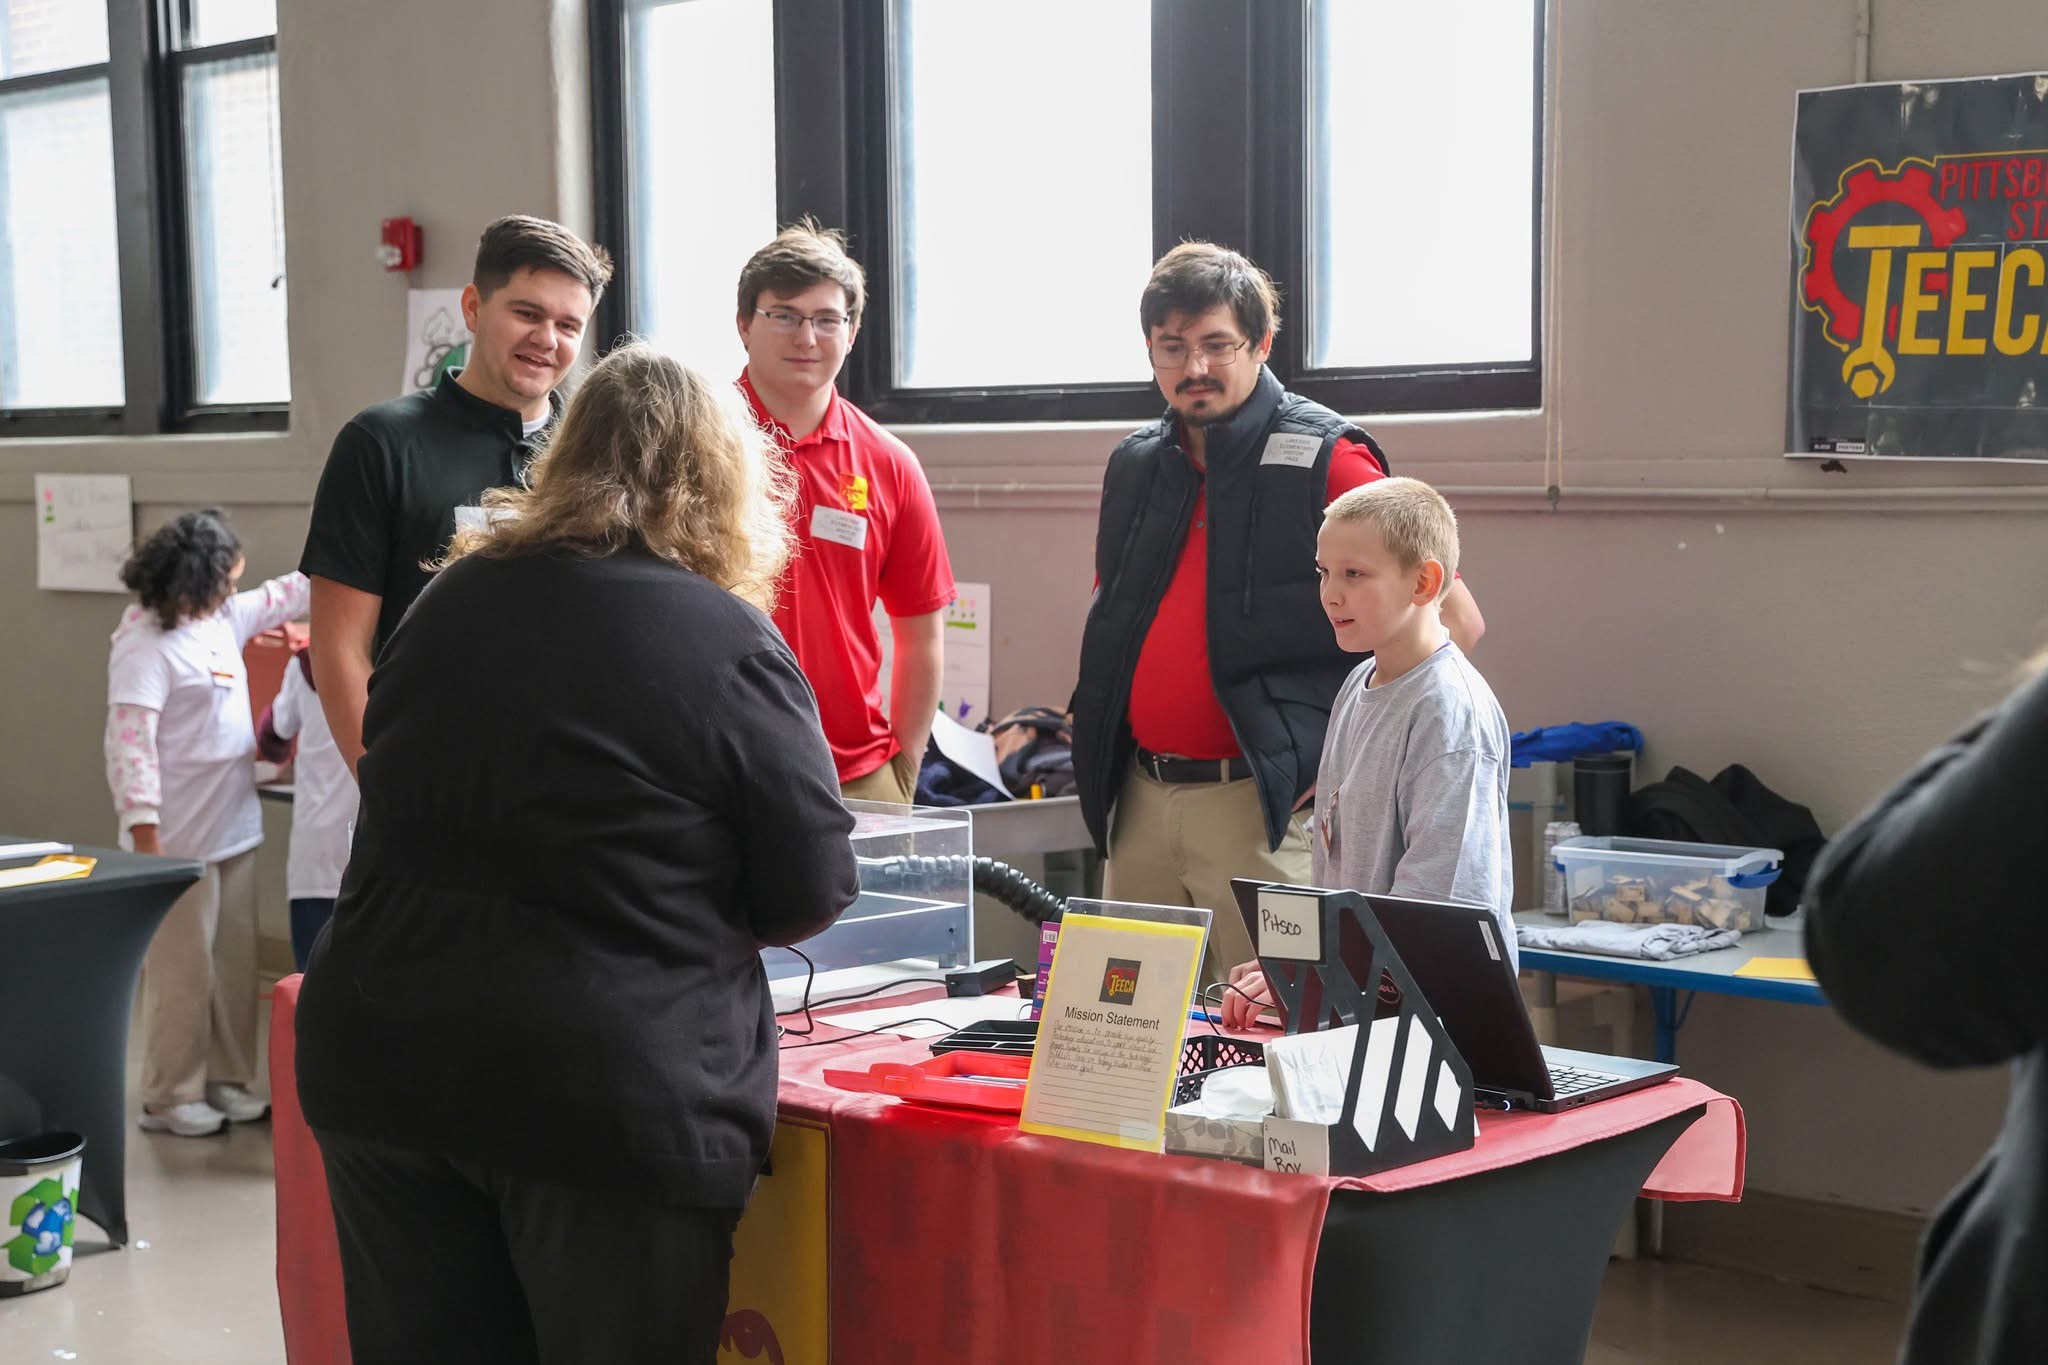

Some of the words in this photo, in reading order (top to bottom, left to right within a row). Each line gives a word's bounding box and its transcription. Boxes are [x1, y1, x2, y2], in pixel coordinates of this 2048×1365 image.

[1938, 157, 2048, 201] PITTSB
[1842, 225, 2048, 398] TEEC
[1261, 908, 1302, 936] Pitsco
[1108, 974, 1135, 997] TEECA
[1064, 1006, 1104, 1023] Mission
[1105, 1011, 1160, 1031] Statement
[1268, 1136, 1296, 1156] Mail
